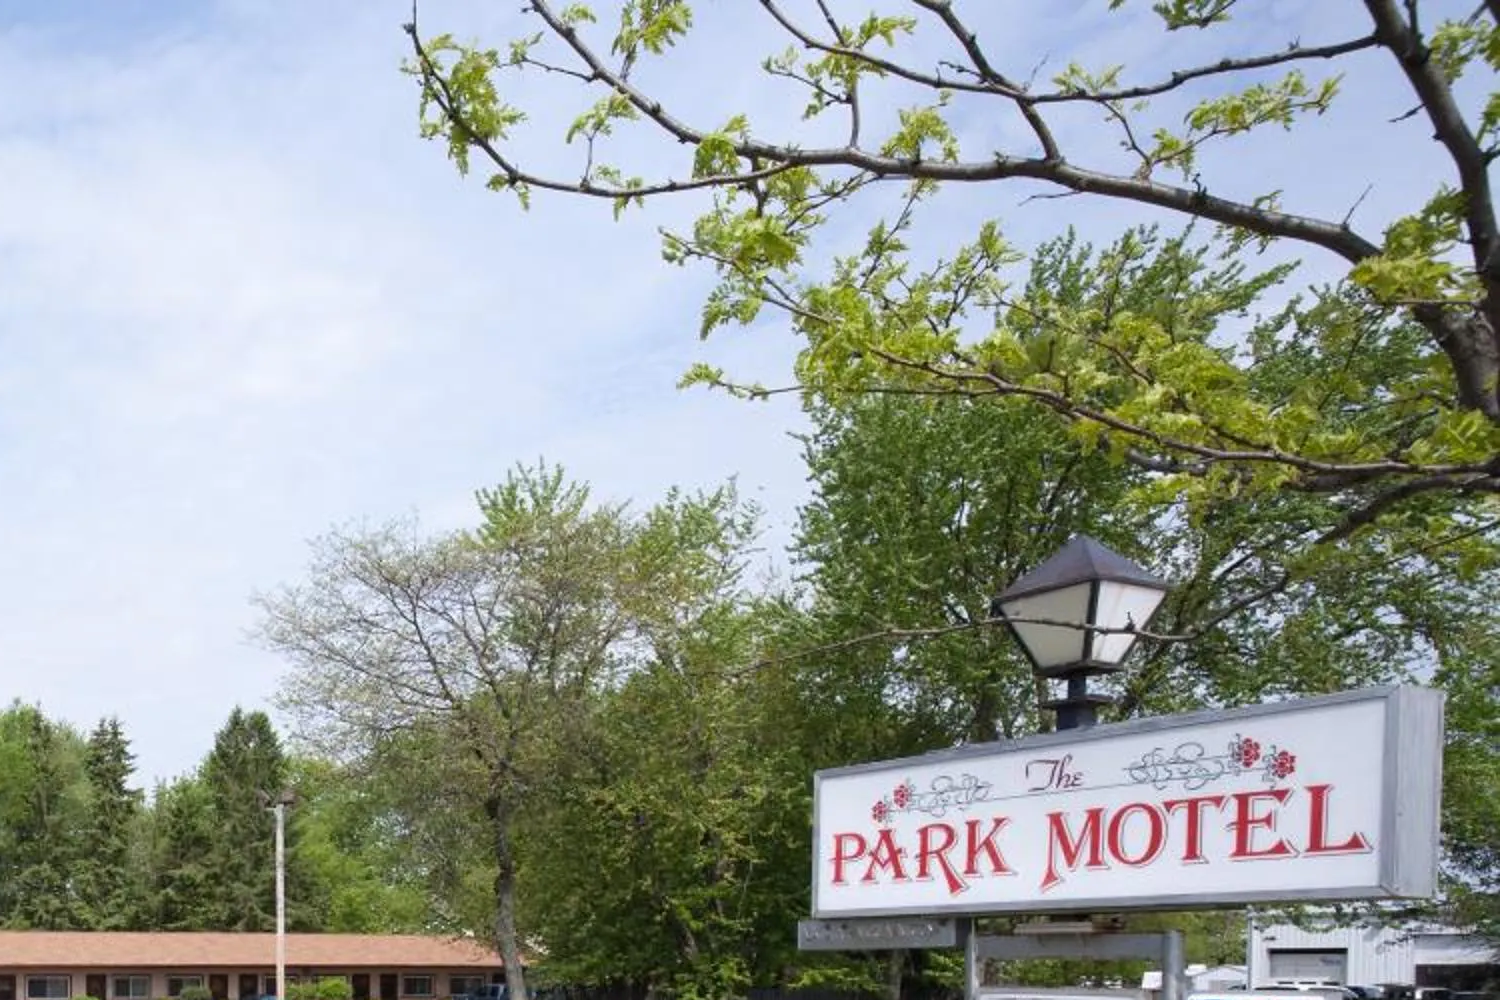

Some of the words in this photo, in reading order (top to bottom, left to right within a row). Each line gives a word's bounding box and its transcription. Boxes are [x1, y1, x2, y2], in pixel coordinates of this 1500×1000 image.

[1025, 754, 1084, 792] The
[829, 817, 1017, 895] PARK
[1041, 784, 1374, 892] MOTEL
